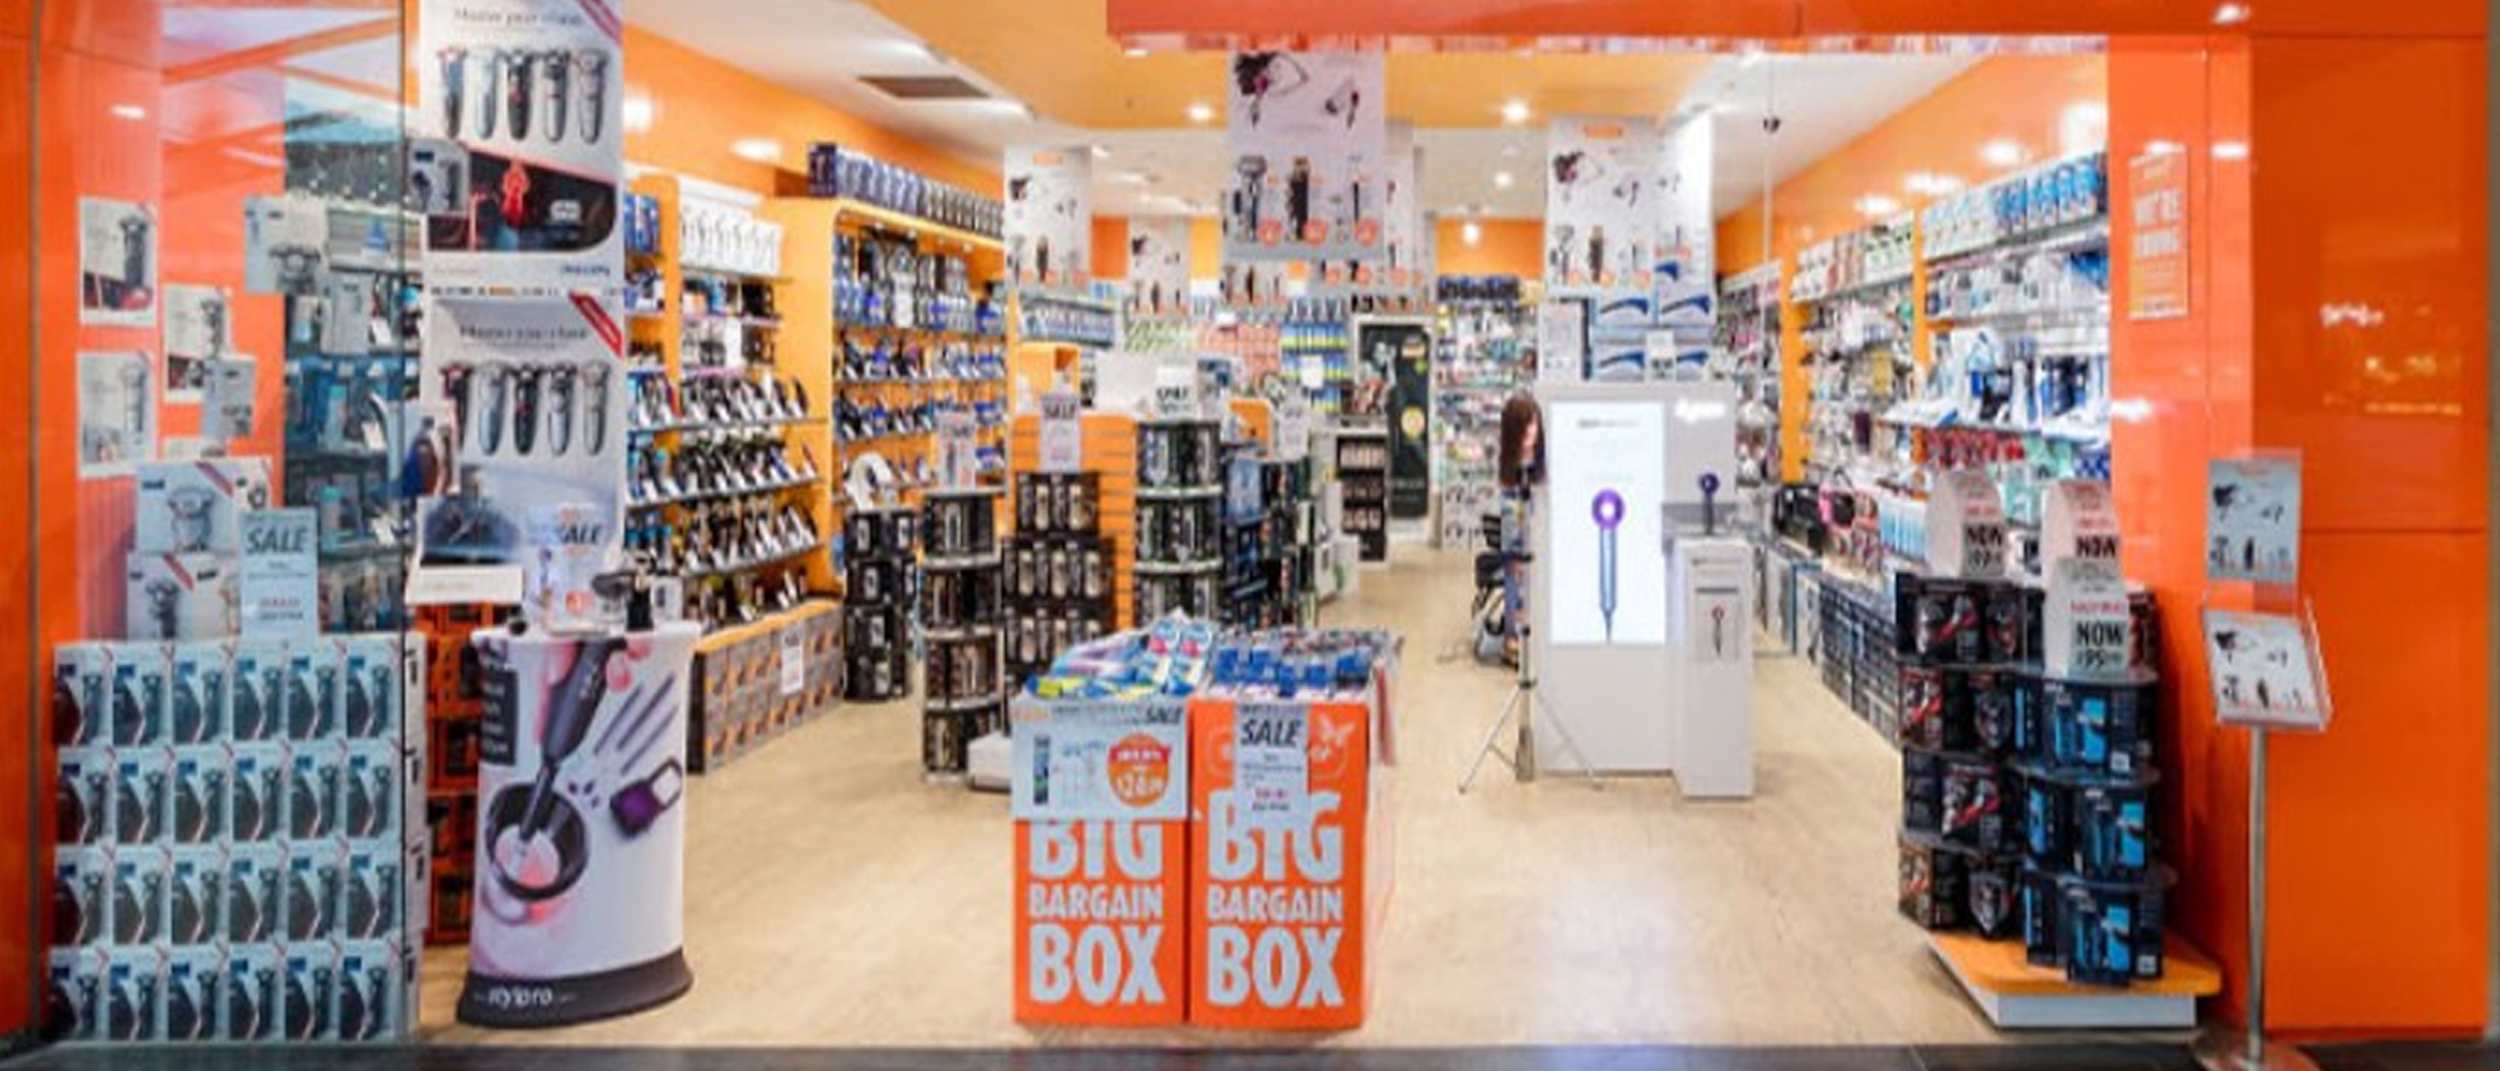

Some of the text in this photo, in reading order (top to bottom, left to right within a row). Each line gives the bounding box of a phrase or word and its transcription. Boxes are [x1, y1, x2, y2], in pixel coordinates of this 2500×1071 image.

[246, 526, 307, 555] SALE
[2075, 619, 2125, 646] NOW
[1240, 718, 1303, 746] SALE
[1030, 822, 1164, 880] BIG
[1209, 792, 1343, 881] BIG
[1028, 884, 1164, 919] BARGAIN
[1208, 884, 1344, 922] BARGAIN
[1030, 923, 1167, 1006] BOX
[1208, 925, 1346, 1010] BOX
